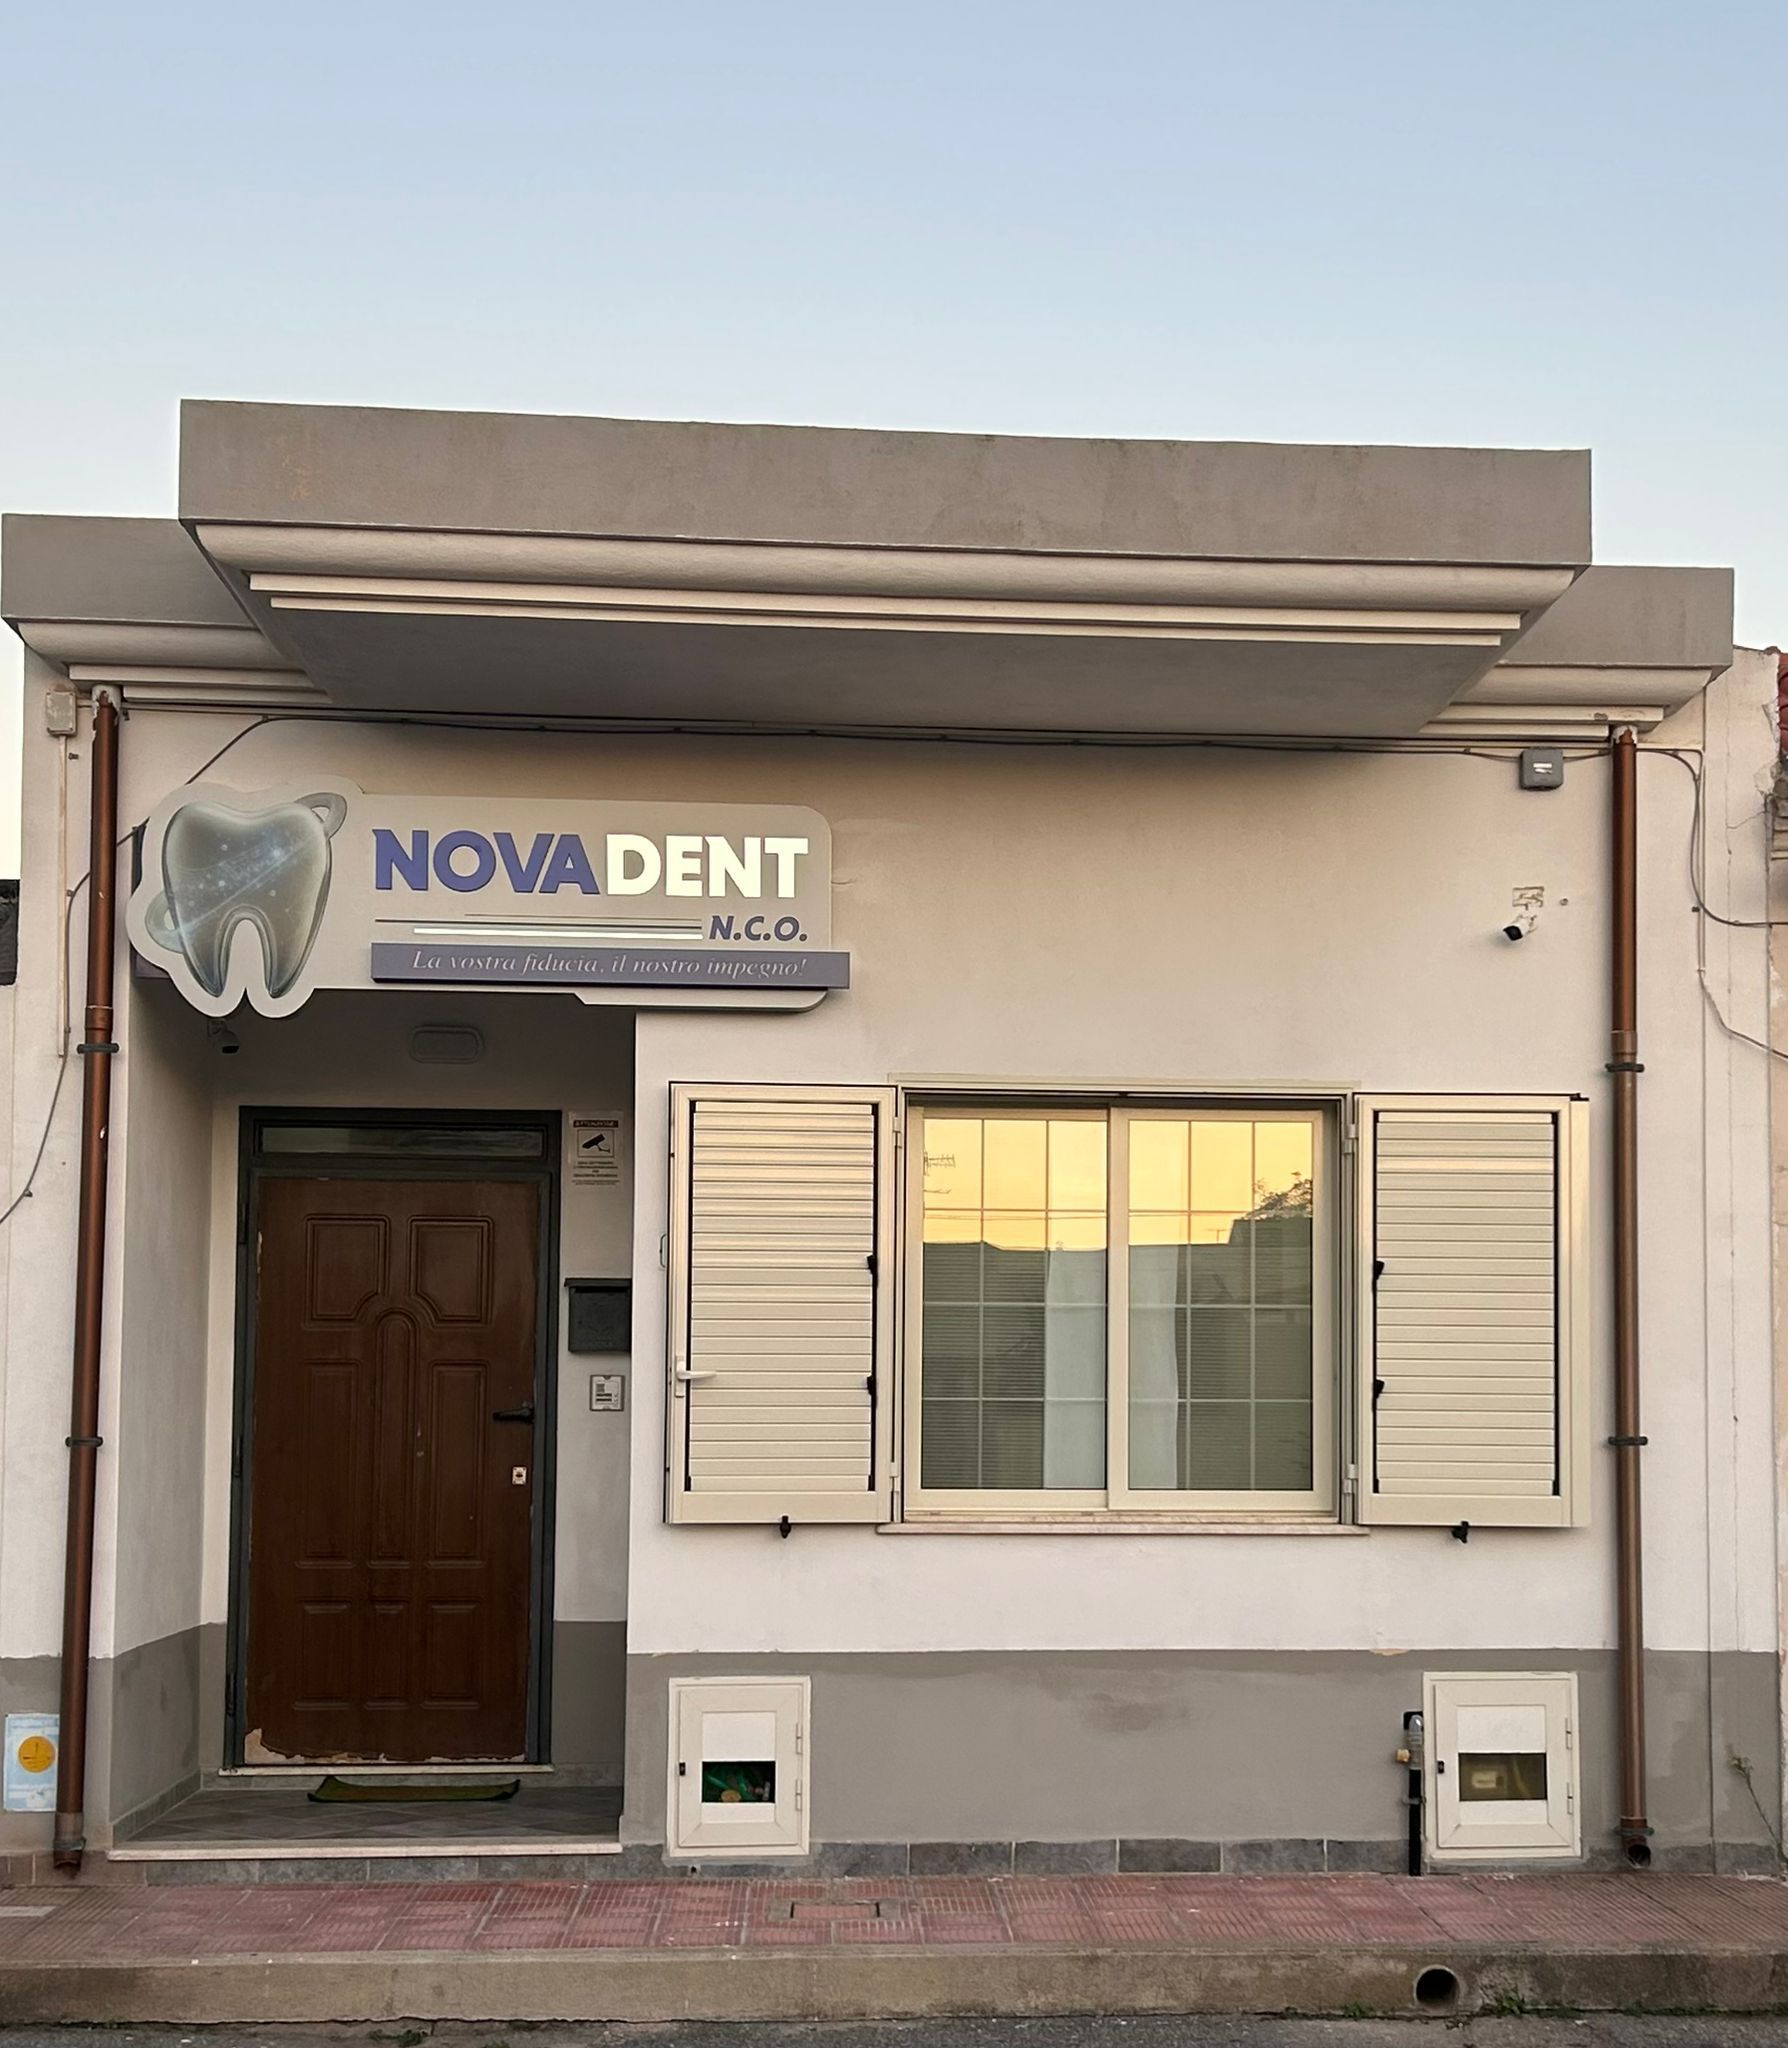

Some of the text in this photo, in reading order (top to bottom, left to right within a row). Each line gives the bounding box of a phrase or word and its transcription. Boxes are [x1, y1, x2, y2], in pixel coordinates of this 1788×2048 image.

[372, 829, 809, 898] NOVADENT
[709, 915, 808, 942] N.C.O.
[412, 951, 808, 979] La vostra fiducia, il nostro impegno!
